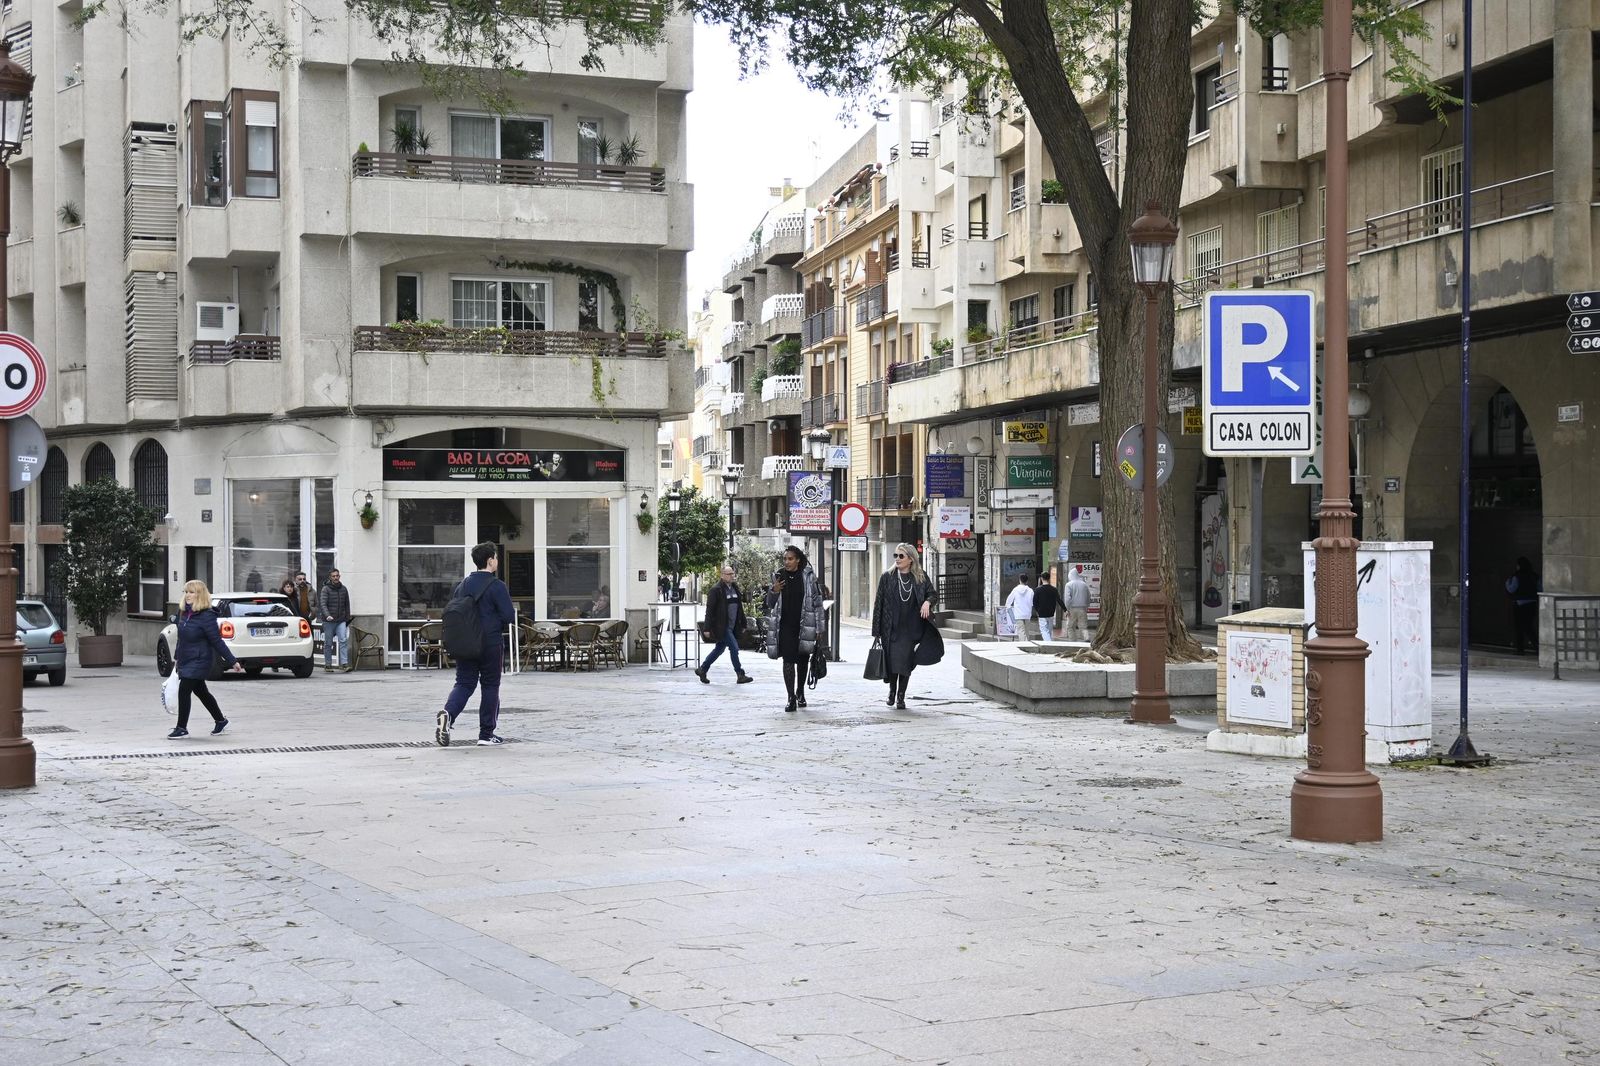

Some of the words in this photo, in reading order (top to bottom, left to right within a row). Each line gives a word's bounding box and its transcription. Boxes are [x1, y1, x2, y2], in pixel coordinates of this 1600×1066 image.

[1221, 304, 1288, 392] P
[1021, 422, 1045, 430] VIDEO
[1219, 422, 1253, 442] CASA
[1260, 422, 1301, 441] COLON
[392, 459, 417, 467] Mahou
[447, 452, 473, 466] BAR
[477, 452, 493, 466] LA
[496, 452, 531, 466] COPA
[1010, 465, 1052, 482] Virginia
[978, 464, 987, 503] SEIKO
[256, 627, 271, 635] 9880
